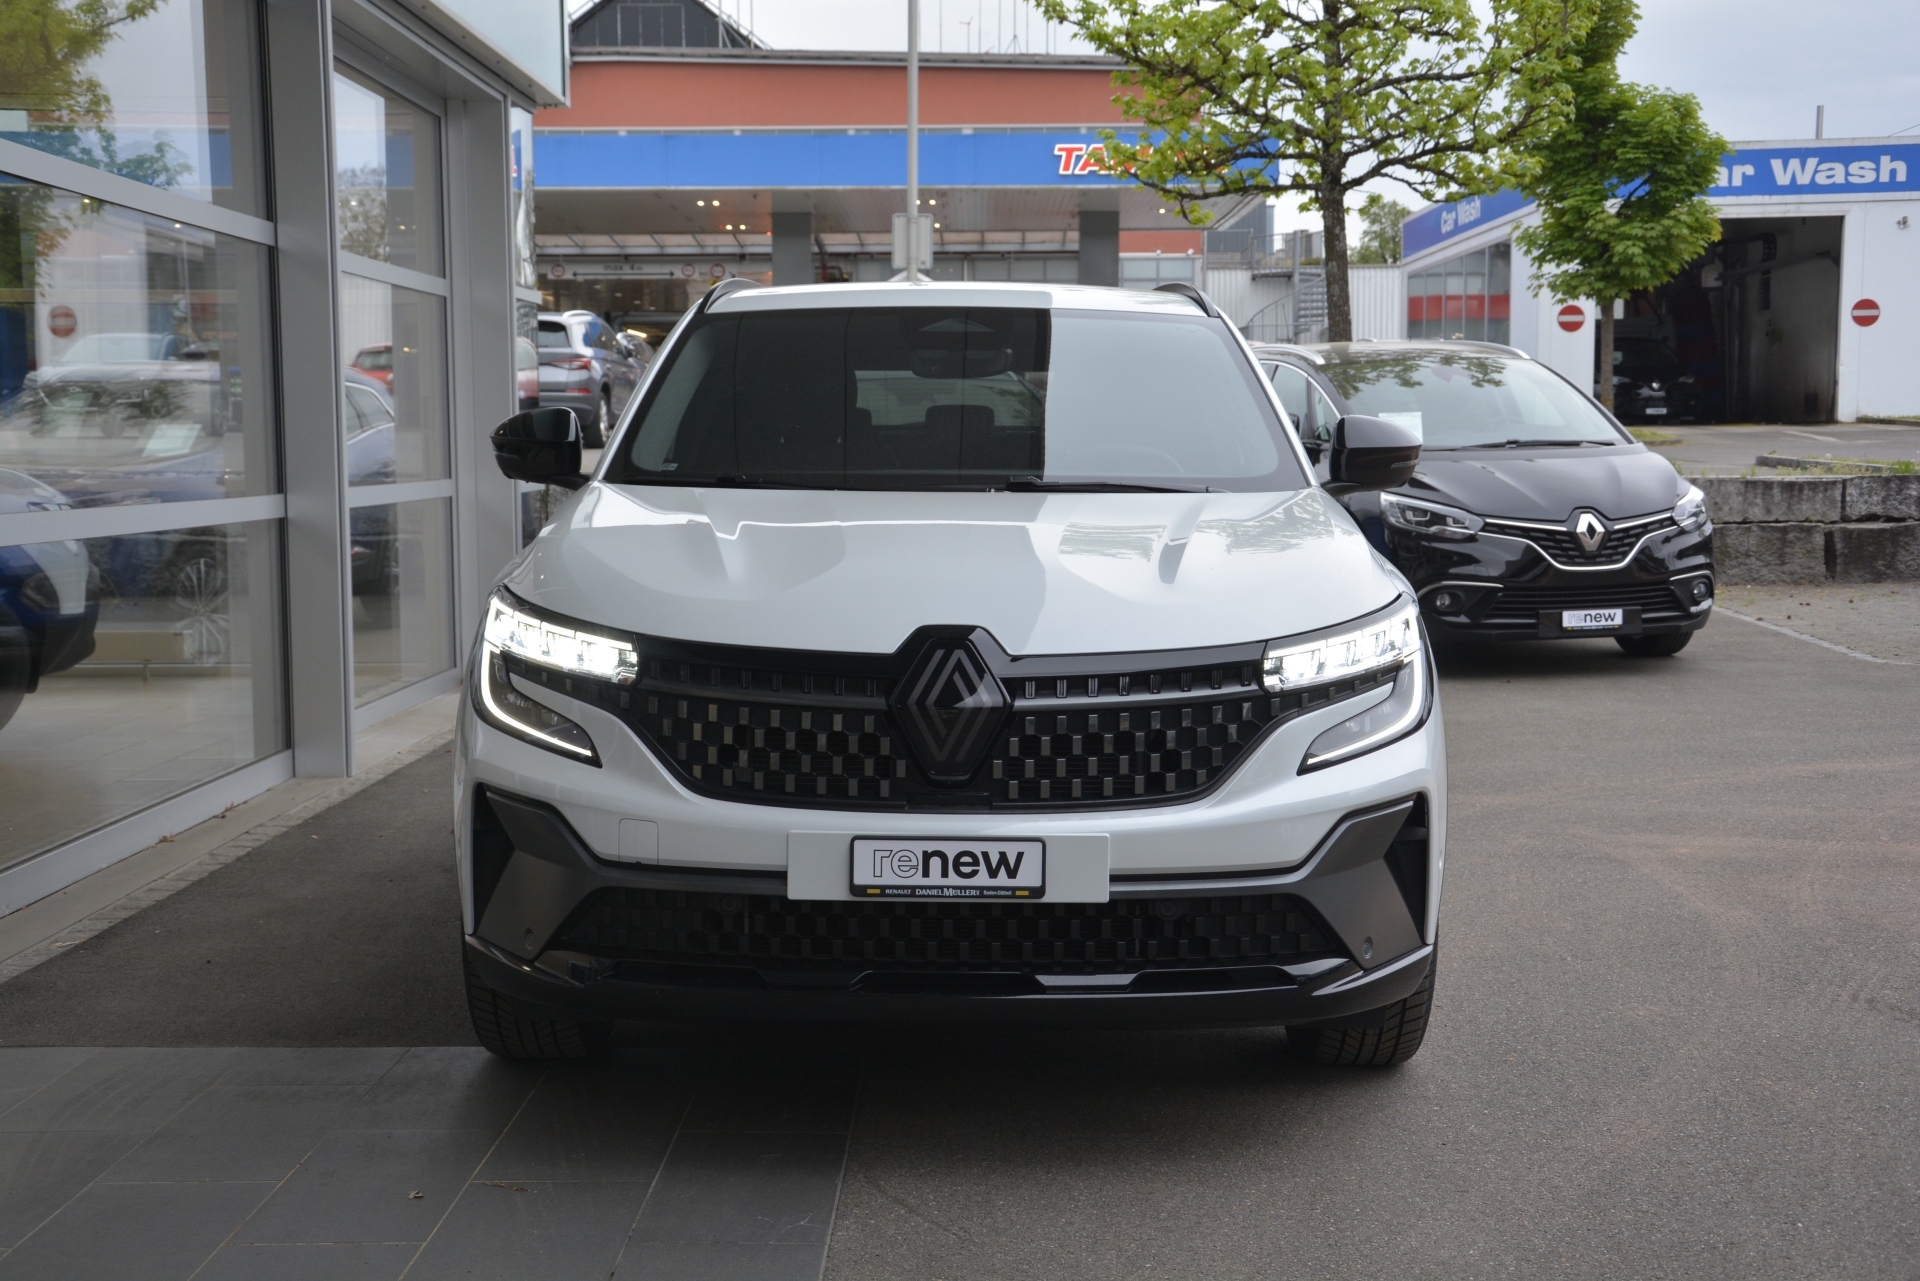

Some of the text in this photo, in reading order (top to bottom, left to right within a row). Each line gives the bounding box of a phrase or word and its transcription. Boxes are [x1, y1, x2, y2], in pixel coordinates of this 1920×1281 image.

[1769, 155, 1907, 186] Wash
[1441, 195, 1481, 234] Car Wash
[1568, 612, 1616, 624] renew
[873, 849, 1025, 879] renew
